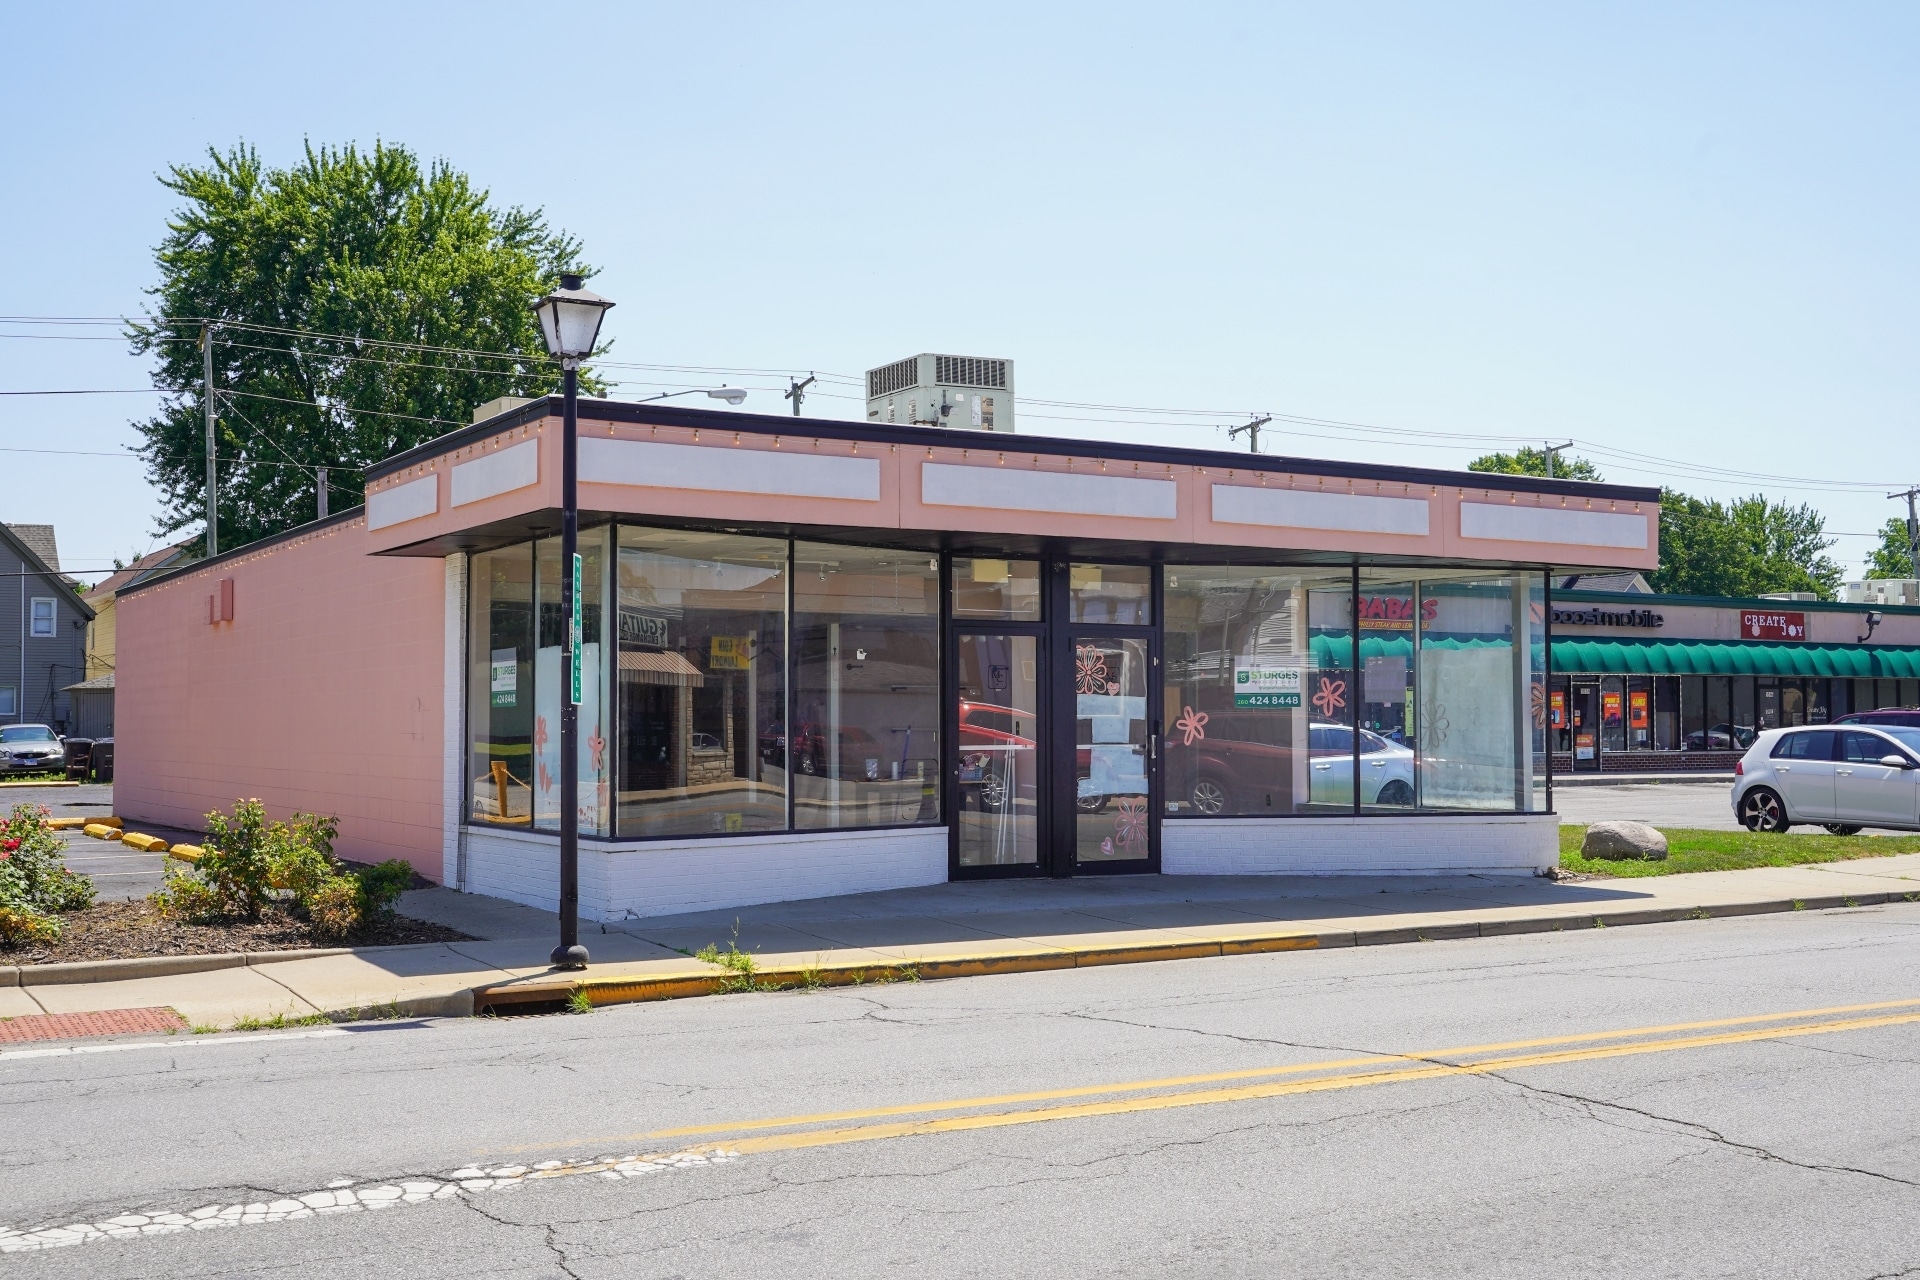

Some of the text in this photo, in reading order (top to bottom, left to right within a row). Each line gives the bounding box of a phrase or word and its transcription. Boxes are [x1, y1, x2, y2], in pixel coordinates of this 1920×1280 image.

[1357, 596, 1439, 620] BABAS
[1374, 621, 1390, 629] STEAK
[1390, 621, 1402, 629] AND
[1402, 621, 1429, 629] LEMDE
[1744, 614, 1786, 627] CREATE
[497, 665, 516, 676] STURGES
[1251, 670, 1298, 680] STURGES
[496, 694, 505, 704] 424
[1249, 696, 1270, 705] 424
[1272, 696, 1299, 705] 8448
